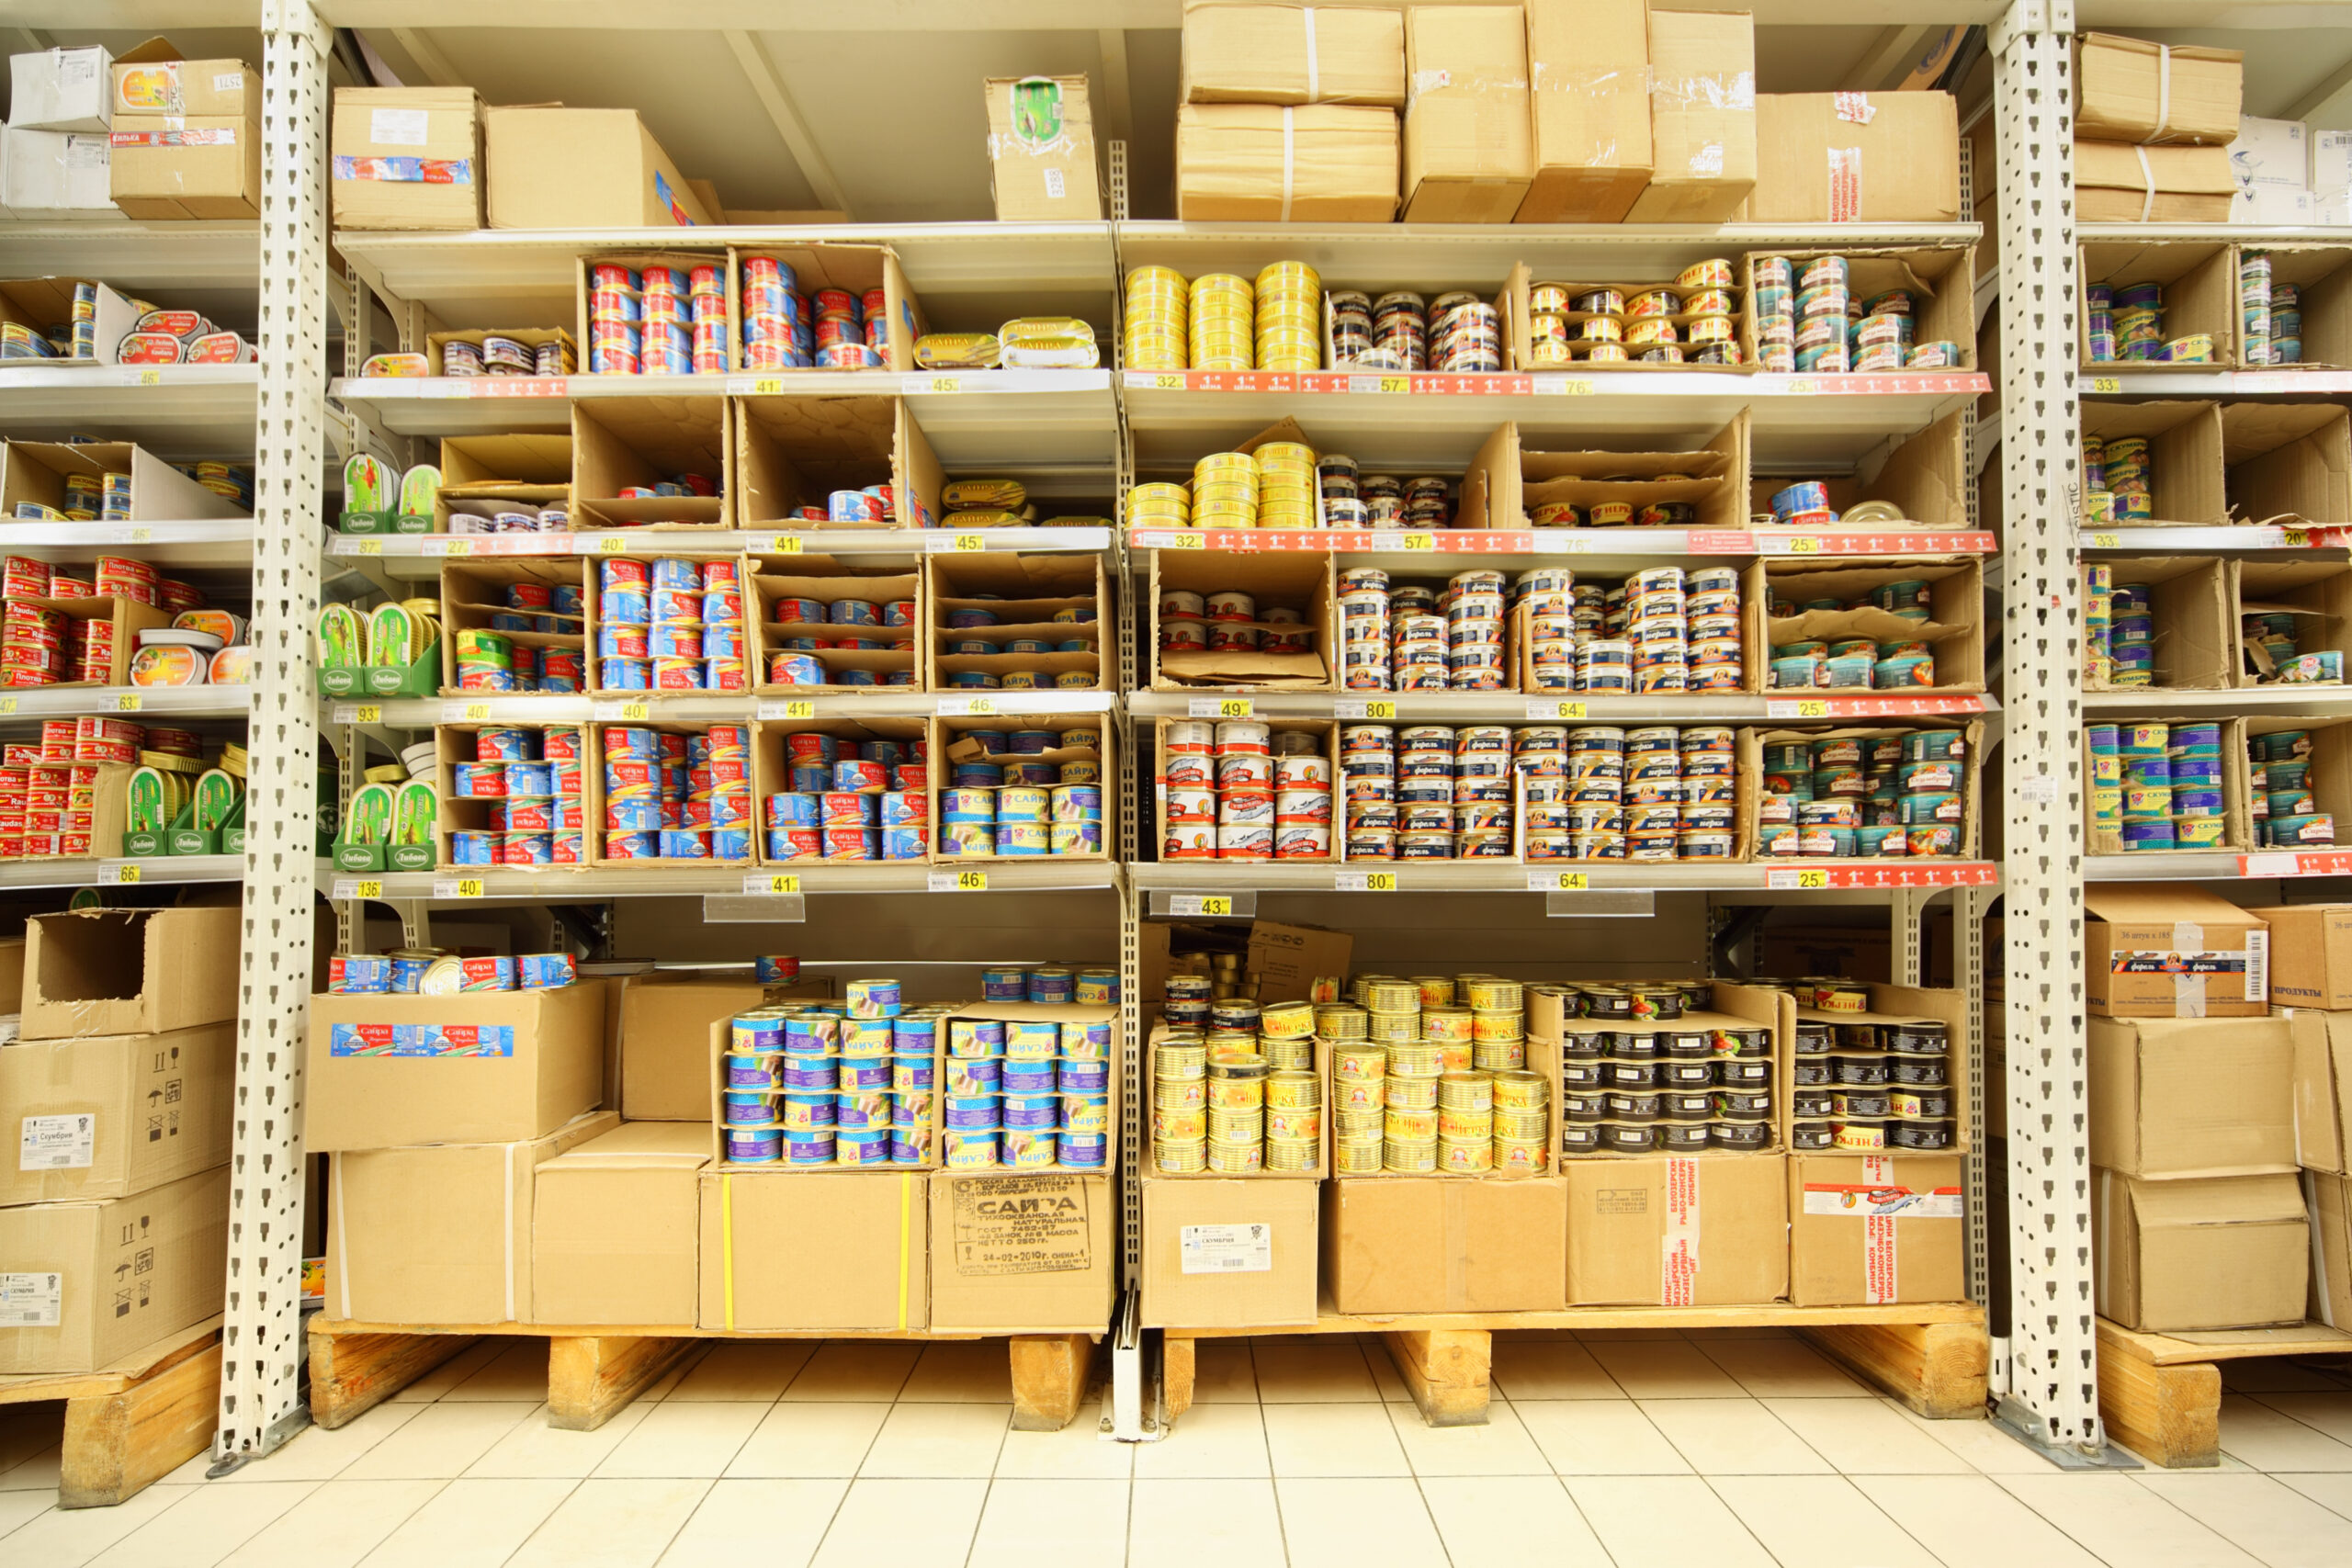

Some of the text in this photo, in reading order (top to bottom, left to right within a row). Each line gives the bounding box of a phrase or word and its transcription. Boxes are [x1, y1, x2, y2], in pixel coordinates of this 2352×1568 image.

[757, 381, 774, 392] 41
[933, 379, 952, 390] 45
[1158, 377, 1176, 388] 32
[1381, 379, 1399, 391] 57
[1567, 381, 1585, 394] 76
[1789, 380, 1804, 391] 25
[2096, 379, 2113, 392] 33
[348, 518, 376, 528] Либава
[602, 538, 617, 550] 40
[777, 538, 793, 550] 41
[958, 536, 977, 549] 45
[1176, 536, 1194, 547] 32
[1405, 536, 1422, 548] 57
[1792, 539, 1808, 551] 25
[2096, 535, 2114, 547] 33
[2286, 534, 2301, 545] 20
[448, 541, 462, 552] 27
[108, 562, 134, 572] Плотва
[14, 605, 38, 616] Raudas
[1647, 605, 1673, 615] нерка
[32, 632, 57, 642] Raudas
[1645, 629, 1671, 639] нерка
[1695, 629, 1721, 639] нерка
[16, 673, 42, 682] Плотва
[326, 674, 352, 684] Либава
[374, 673, 401, 685] Либава
[1060, 676, 1092, 685] САЙРА
[119, 697, 131, 710] 63
[789, 703, 806, 715] 41
[970, 699, 989, 711] 46
[358, 707, 374, 721] 93
[468, 705, 483, 717] 40
[625, 705, 640, 717] 40
[1222, 703, 1240, 716] 49
[1366, 704, 1385, 716] 80
[1559, 703, 1577, 716] 64
[1801, 703, 1818, 716] 25
[1065, 735, 1096, 744] САЙРА
[1528, 740, 1553, 750] нерка
[1411, 741, 1438, 750] форель
[1472, 741, 1498, 750] форель
[1630, 742, 1655, 750] нерка
[1648, 768, 1672, 776] нерка
[1690, 766, 1715, 774] нерка
[1585, 792, 1610, 800] нерка
[1363, 818, 1388, 827] форель
[1410, 820, 1437, 829] форель
[1647, 819, 1671, 829] нерка
[1699, 819, 1724, 828] нерка
[132, 838, 156, 850] Либава
[177, 837, 202, 849] Либава
[344, 852, 371, 863] Либава
[398, 852, 426, 863] Либава
[120, 867, 134, 881] 66
[775, 878, 791, 891] 41
[960, 873, 978, 887] 46
[1367, 874, 1385, 888] 80
[1560, 874, 1578, 887] 64
[1801, 874, 1818, 887] 25
[360, 882, 377, 897] 136
[460, 881, 475, 895] 40
[1202, 900, 1221, 914] 43
[465, 963, 492, 972] Сайра
[2131, 963, 2155, 972] форель
[2193, 962, 2217, 972] форель
[2274, 986, 2322, 998] ПРОДУКТЫ
[360, 1026, 390, 1036] Сайра
[446, 1028, 474, 1036] Сайра
[40, 1133, 73, 1141] Скумбрия
